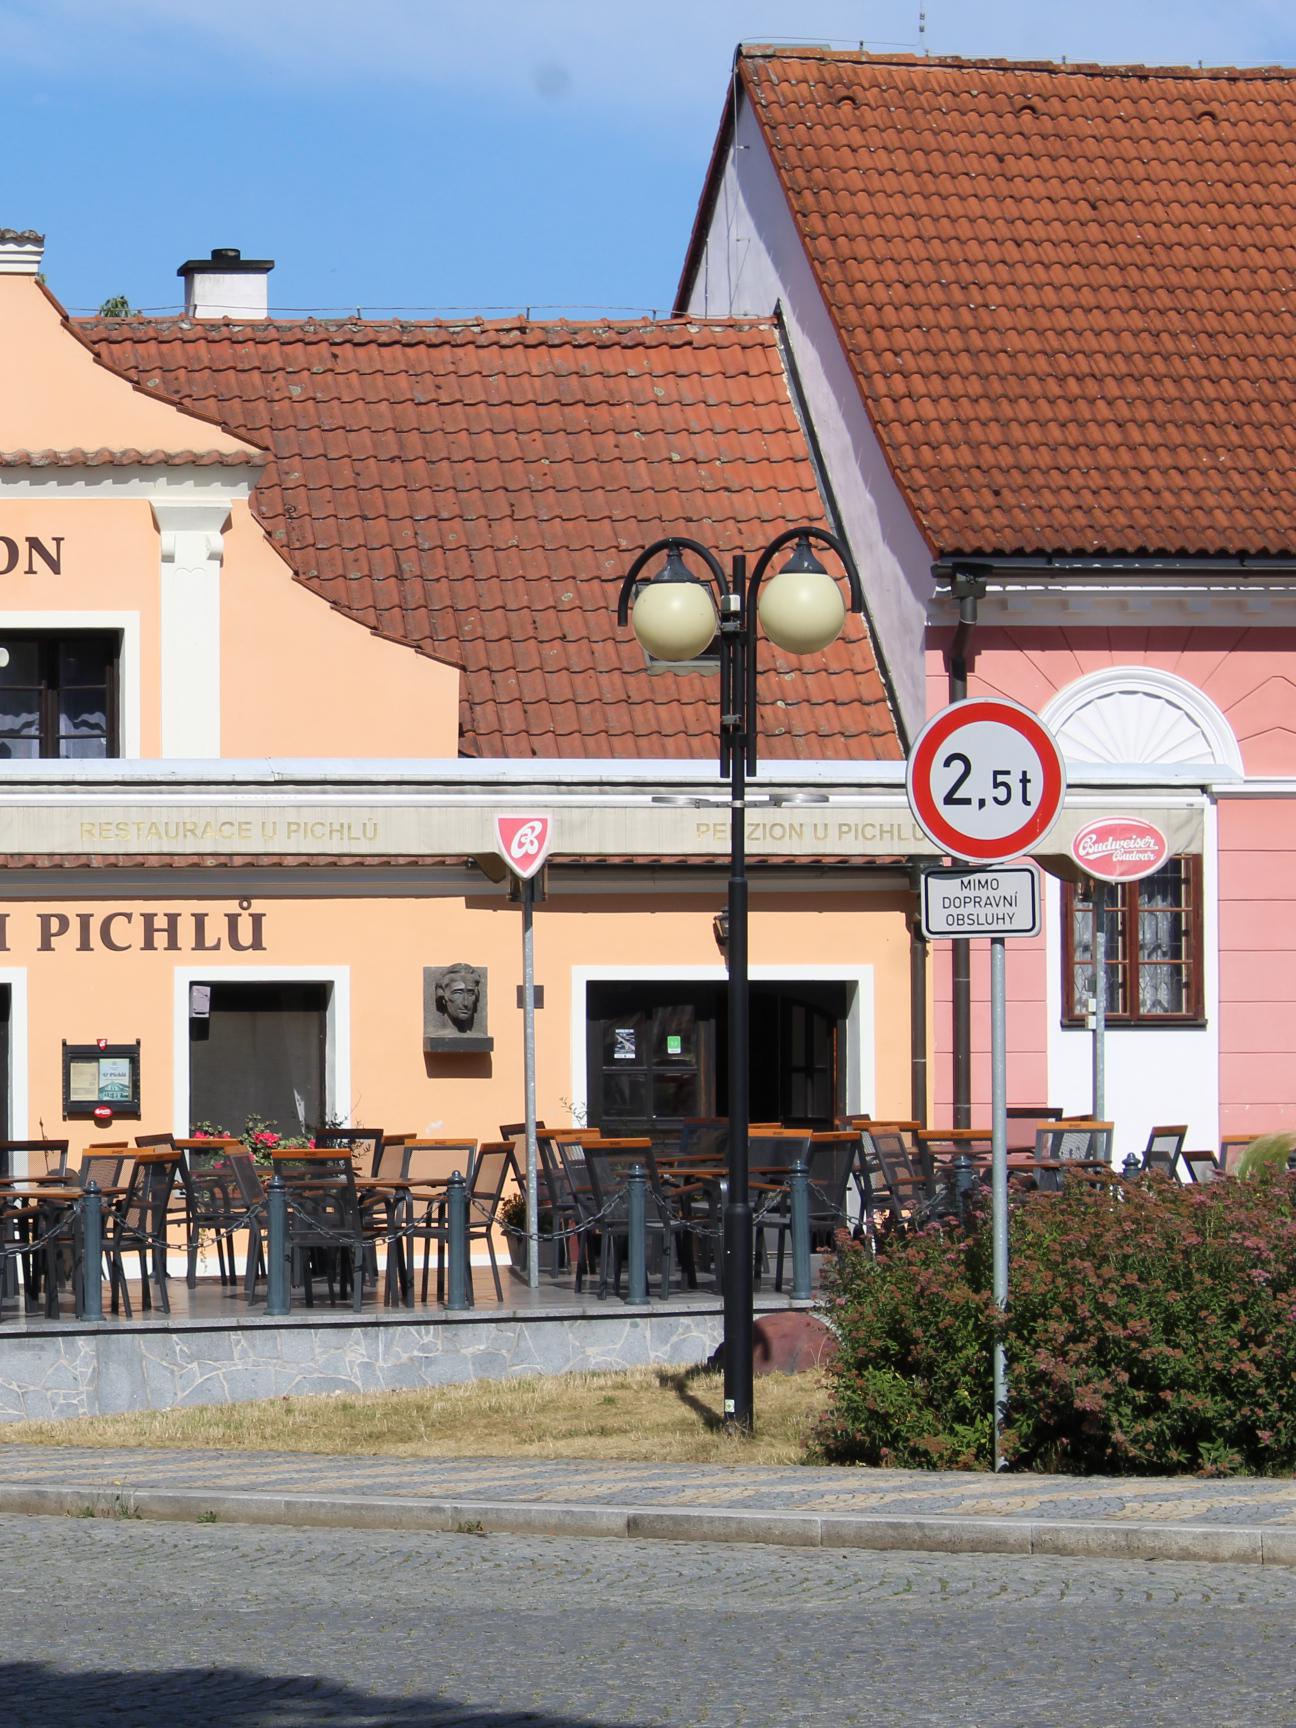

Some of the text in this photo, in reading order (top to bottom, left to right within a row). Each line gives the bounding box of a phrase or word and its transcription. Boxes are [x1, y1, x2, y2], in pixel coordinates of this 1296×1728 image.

[79, 821, 254, 842] RESTAURACE
[261, 820, 278, 841] U
[695, 822, 804, 842] PEZION
[812, 823, 830, 842] U
[1078, 834, 1159, 857] Budweiser
[1112, 848, 1157, 862] Budvar
[960, 878, 1000, 892] MIMO
[942, 891, 1018, 909] DOPRAVNÍ
[36, 898, 268, 952] PICHLŮ
[946, 913, 1016, 927] OBSLUHY
